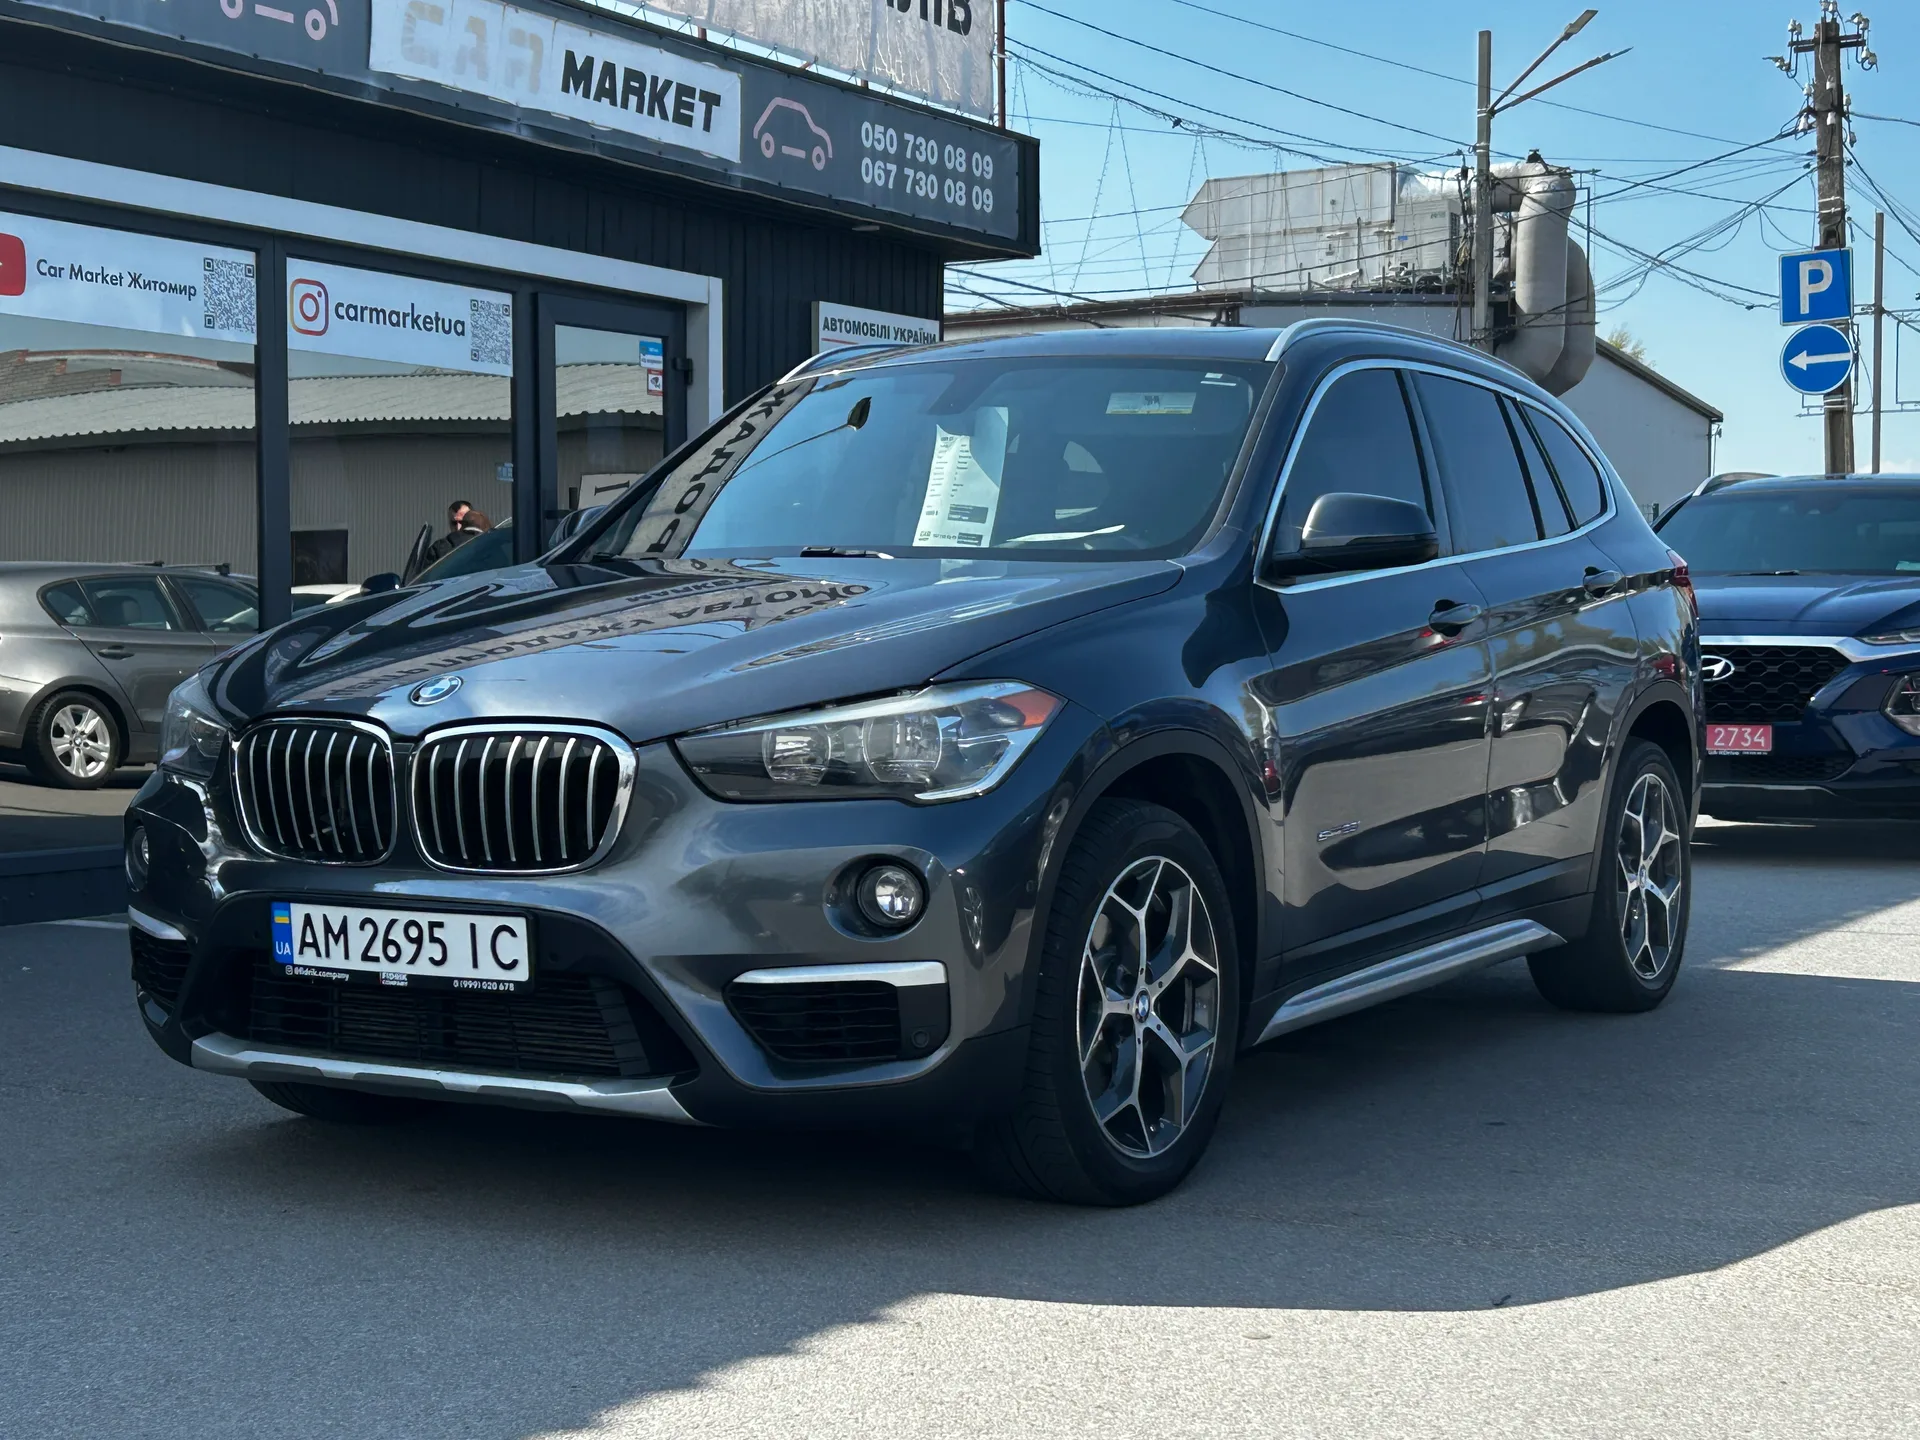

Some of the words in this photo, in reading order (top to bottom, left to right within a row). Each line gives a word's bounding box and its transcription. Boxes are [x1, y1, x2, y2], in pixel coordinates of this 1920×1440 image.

[561, 49, 721, 133] MARKET
[861, 121, 898, 155] 050
[904, 132, 938, 165] 730
[944, 144, 966, 173] 08
[972, 151, 993, 180] 09
[861, 157, 897, 189] 067
[904, 167, 938, 200] 730
[944, 178, 966, 206] 08
[972, 185, 993, 213] 09
[36, 259, 65, 278] Car
[69, 263, 124, 287] Market
[127, 271, 197, 301] Житомир
[1799, 259, 1833, 314] P
[334, 302, 466, 337] carmarketua
[823, 316, 890, 340] АВТОМОБІЛІ
[893, 327, 936, 344] УКРАЇНИ
[1714, 728, 1765, 747] 2734
[276, 941, 292, 956] UA
[298, 912, 350, 961] AM
[359, 916, 448, 967] 2695
[469, 922, 520, 971] IC
